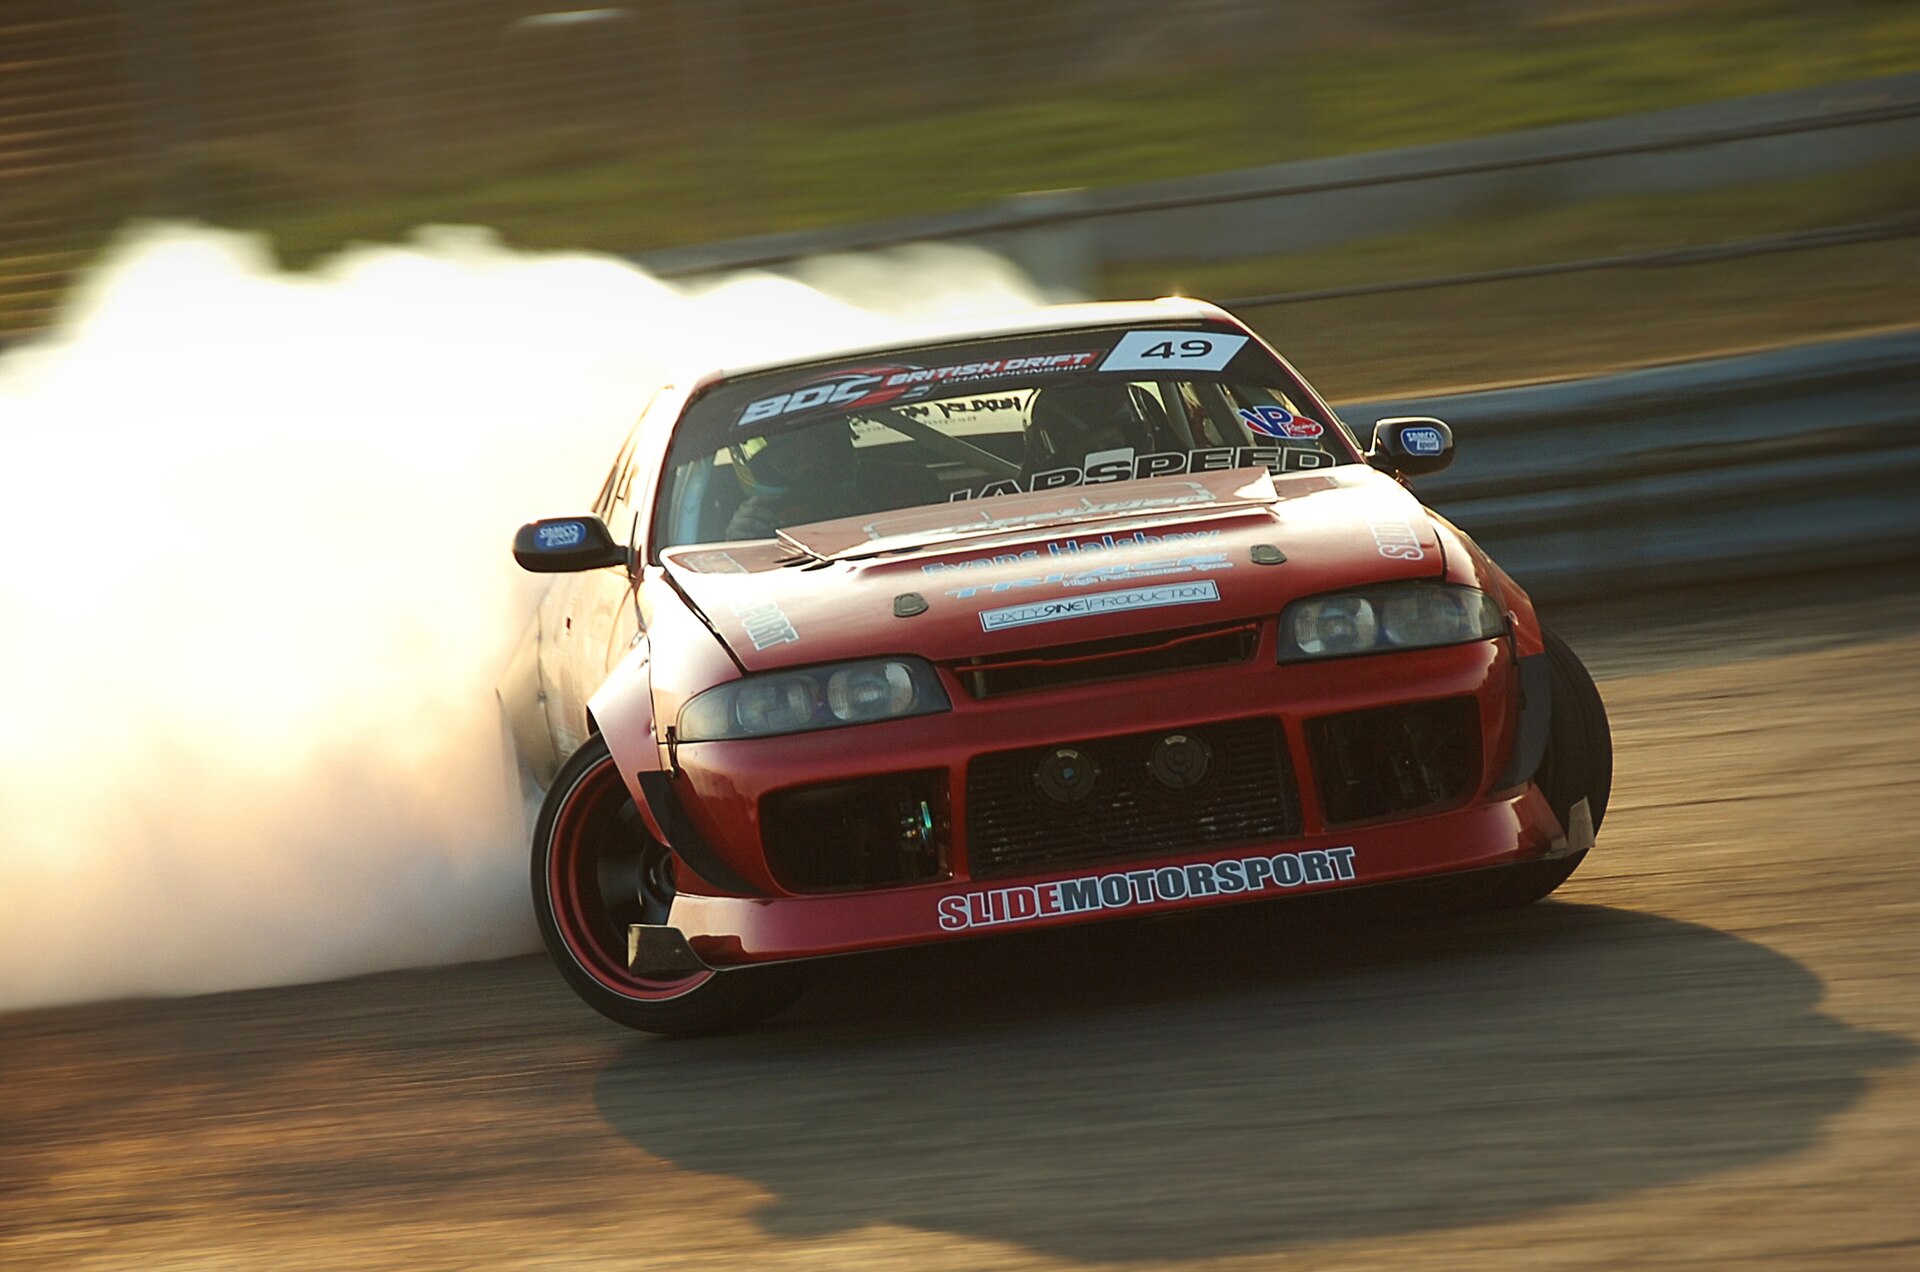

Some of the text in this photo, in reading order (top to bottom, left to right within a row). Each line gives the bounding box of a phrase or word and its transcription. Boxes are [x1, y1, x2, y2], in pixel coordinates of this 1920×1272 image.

[1140, 339, 1213, 359] 49
[887, 352, 1093, 387] BRITISH DRIFT
[941, 364, 1087, 385] CHAMPIONSHIP
[737, 374, 885, 427] BDC
[1238, 405, 1294, 437] VP
[921, 528, 1221, 579] Evans Halshaw
[1088, 585, 1208, 608] PRODUCTION
[937, 846, 1356, 931] SLIDEMOTORSPORT
